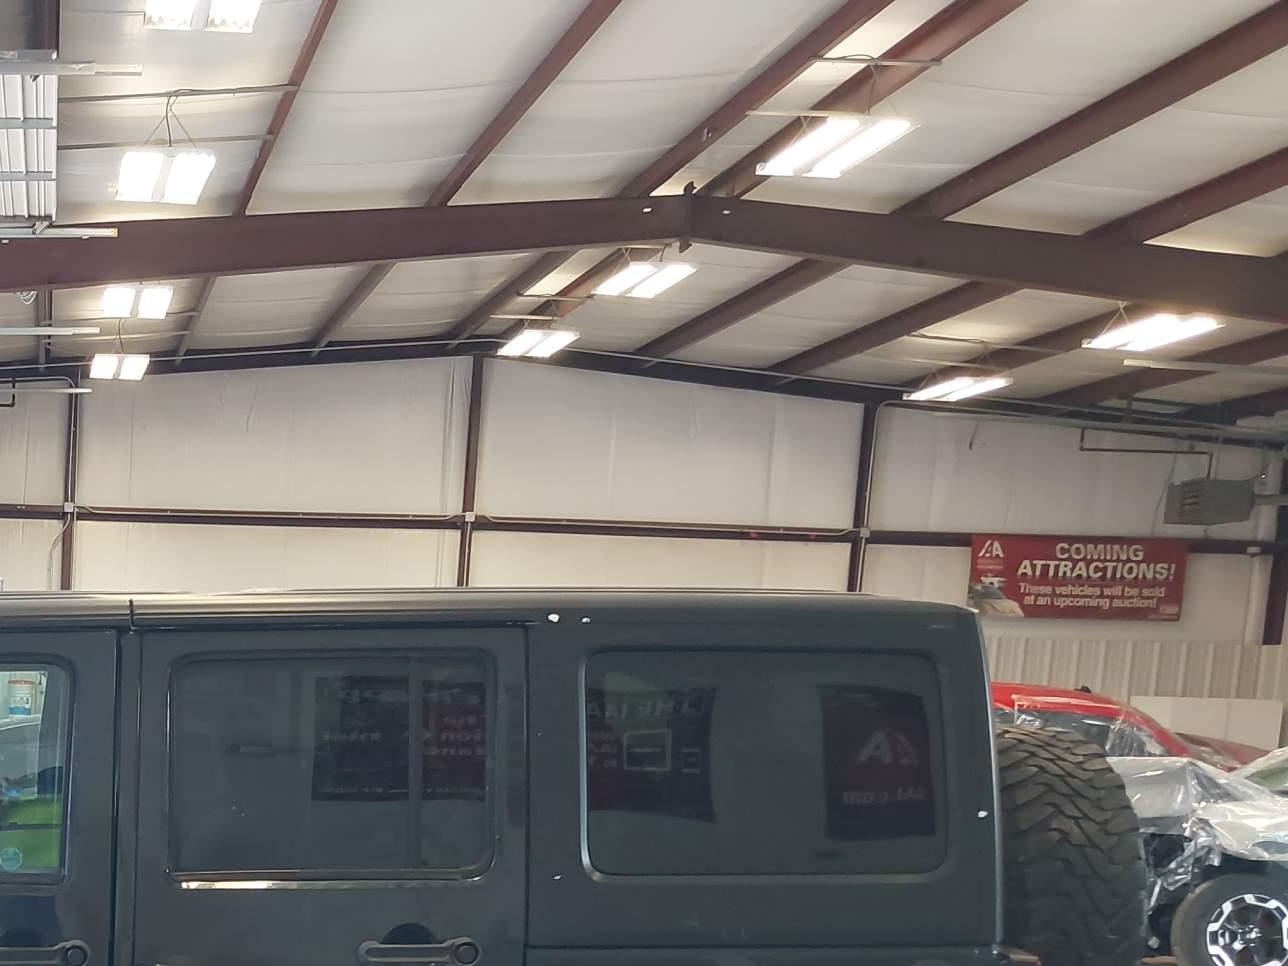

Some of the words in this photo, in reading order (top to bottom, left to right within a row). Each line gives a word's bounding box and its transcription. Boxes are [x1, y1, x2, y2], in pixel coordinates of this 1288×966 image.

[1055, 543, 1144, 561] COMING
[1016, 560, 1176, 580] ATTRACTIONS!
[1018, 582, 1052, 594] These
[1055, 584, 1100, 596] vehicles
[1104, 585, 1122, 596] will
[1124, 586, 1139, 597] be
[1141, 586, 1165, 597] sold
[1023, 595, 1034, 605] at
[1036, 596, 1051, 605] an
[1053, 597, 1109, 610] upcoming
[1112, 598, 1157, 608] auction!
